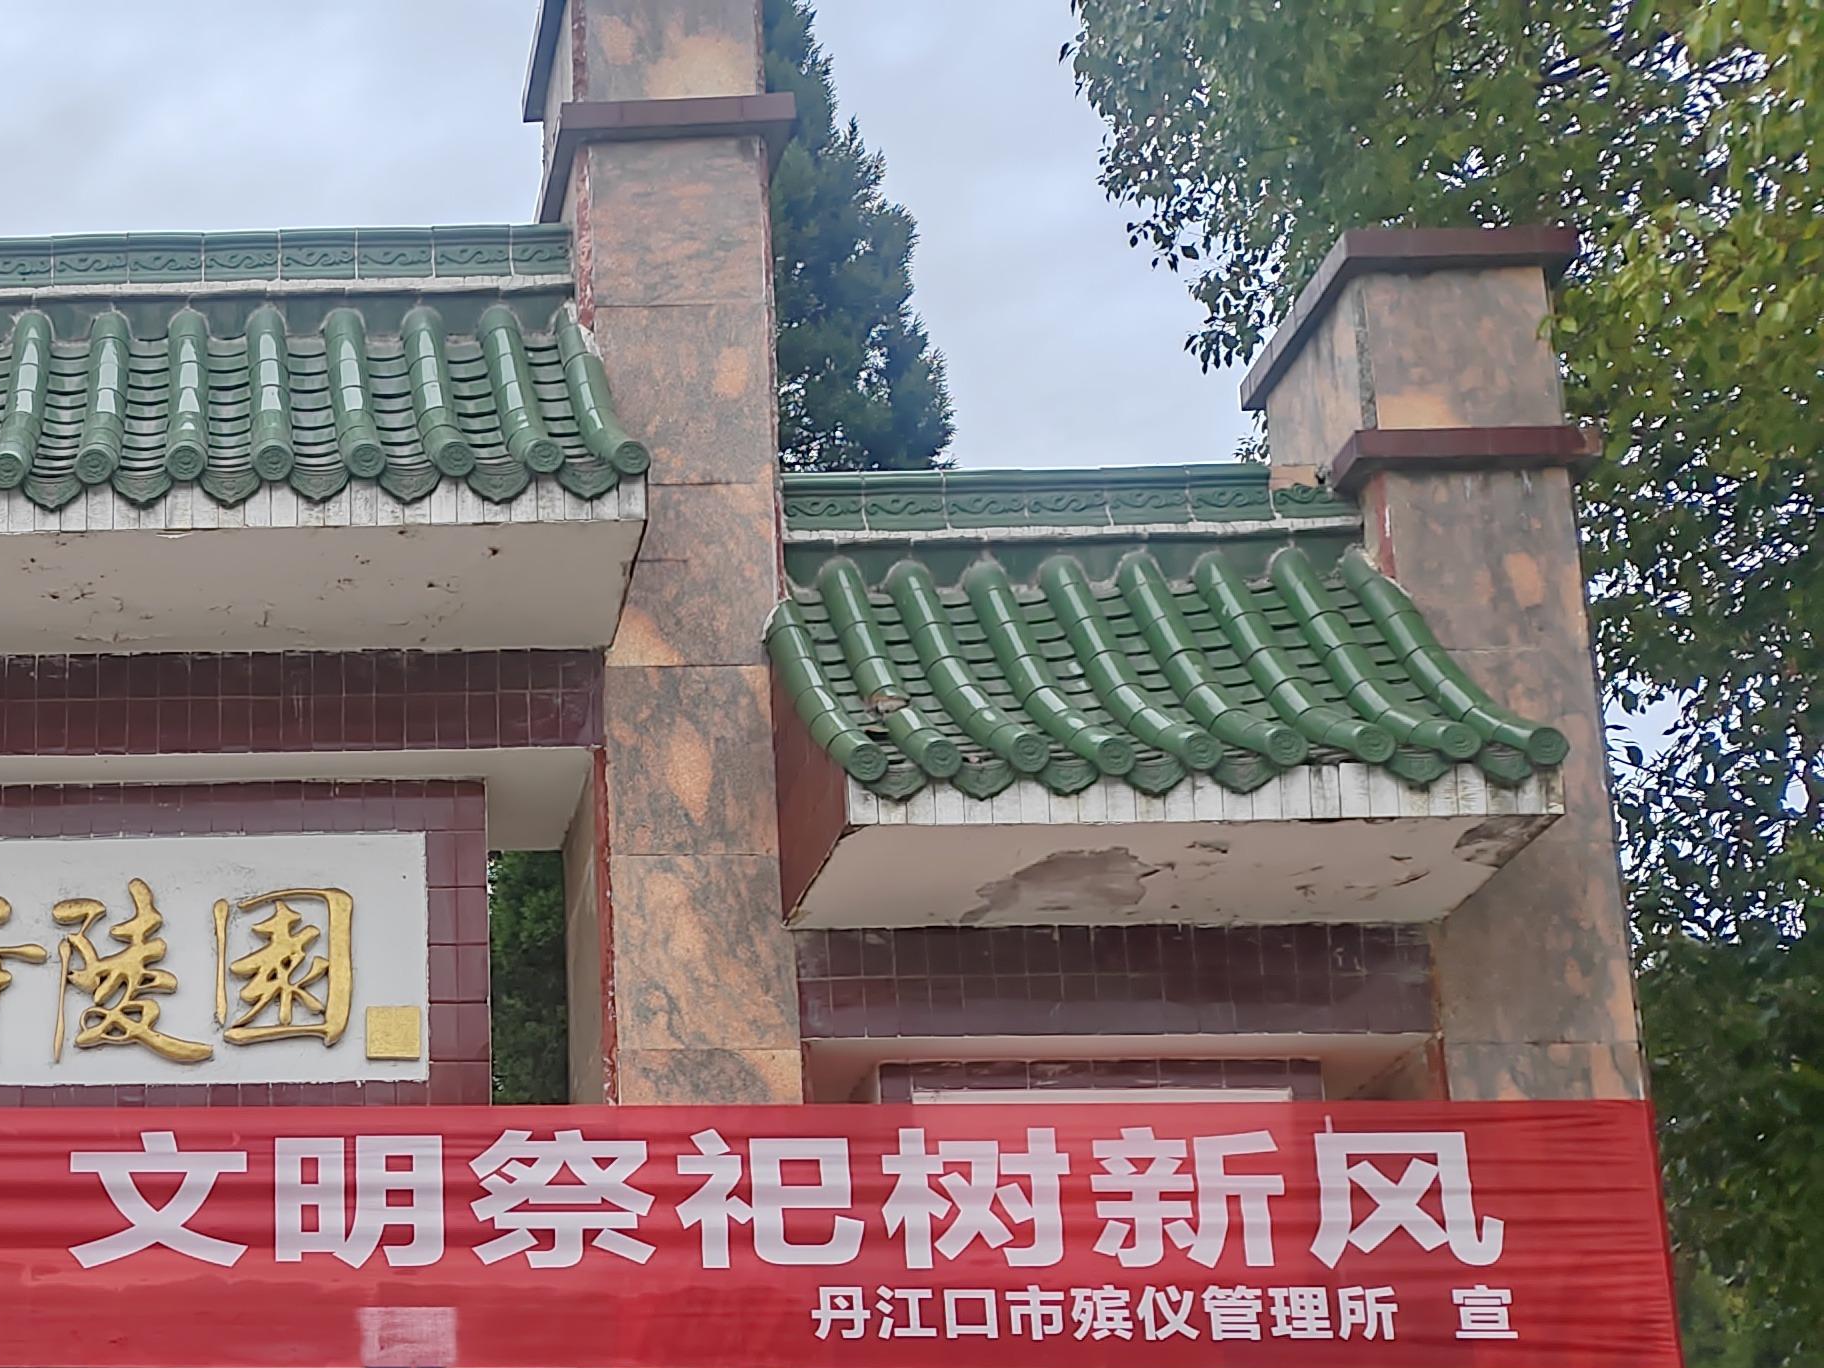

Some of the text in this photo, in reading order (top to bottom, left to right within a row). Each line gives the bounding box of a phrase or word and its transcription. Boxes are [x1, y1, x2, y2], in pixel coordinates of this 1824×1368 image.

[67, 1127, 1505, 1270] 文明祭祀树新风
[810, 1284, 1519, 1342] 丹江口市殡仪管理所 宣
